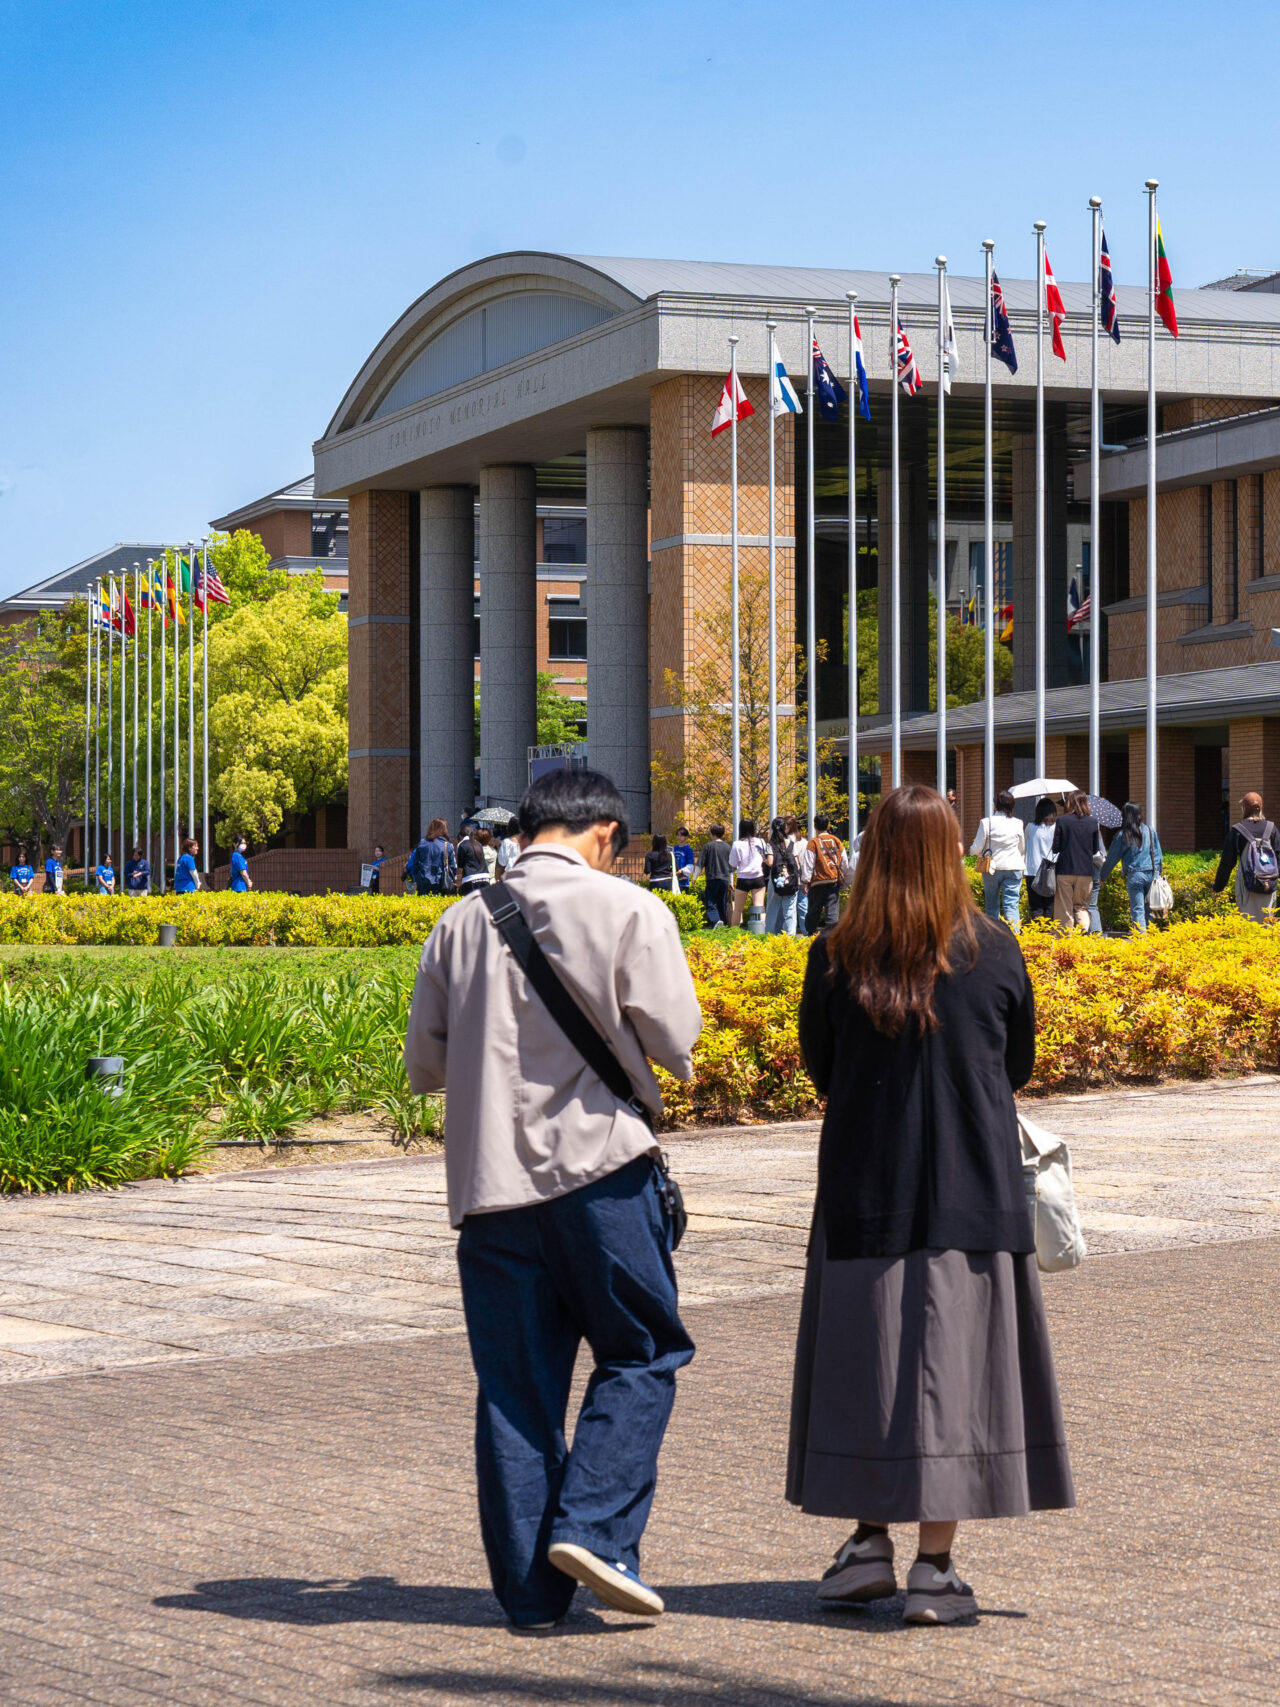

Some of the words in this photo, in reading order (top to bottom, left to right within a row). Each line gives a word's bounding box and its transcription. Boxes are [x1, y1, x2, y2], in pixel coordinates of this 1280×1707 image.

[388, 415, 441, 450] TANIMOTO
[450, 389, 507, 425] MEMORIAL
[516, 373, 547, 399] HALL
